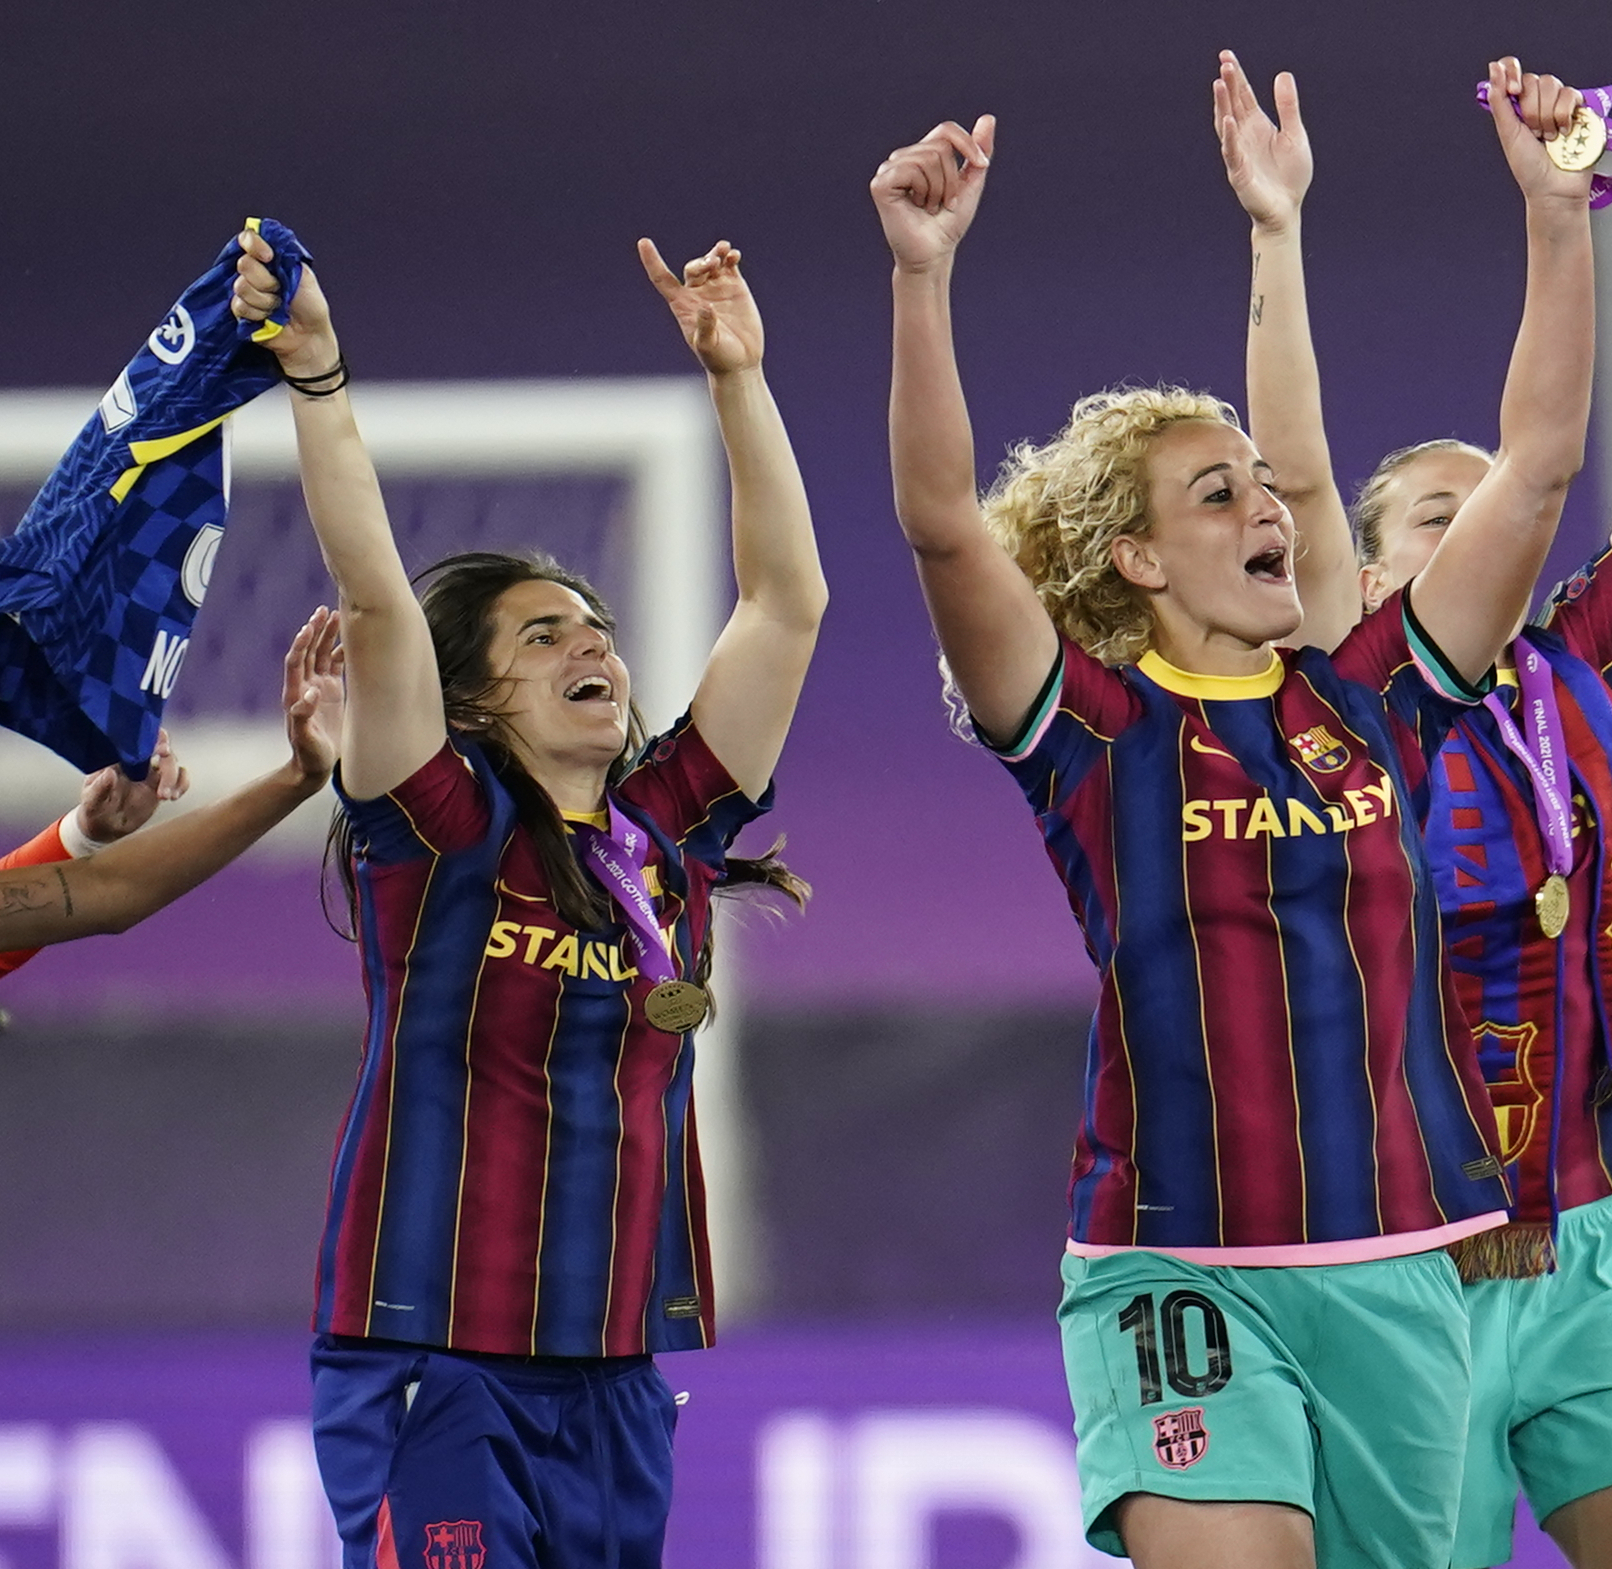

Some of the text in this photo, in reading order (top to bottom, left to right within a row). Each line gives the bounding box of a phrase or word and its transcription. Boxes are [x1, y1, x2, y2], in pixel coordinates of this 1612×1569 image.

[1532, 698, 1548, 735] FINAL
[1538, 734, 1553, 760] 2021
[1182, 774, 1393, 842] STANLEY
[606, 859, 625, 881] 2021
[1118, 1289, 1233, 1407] 10
